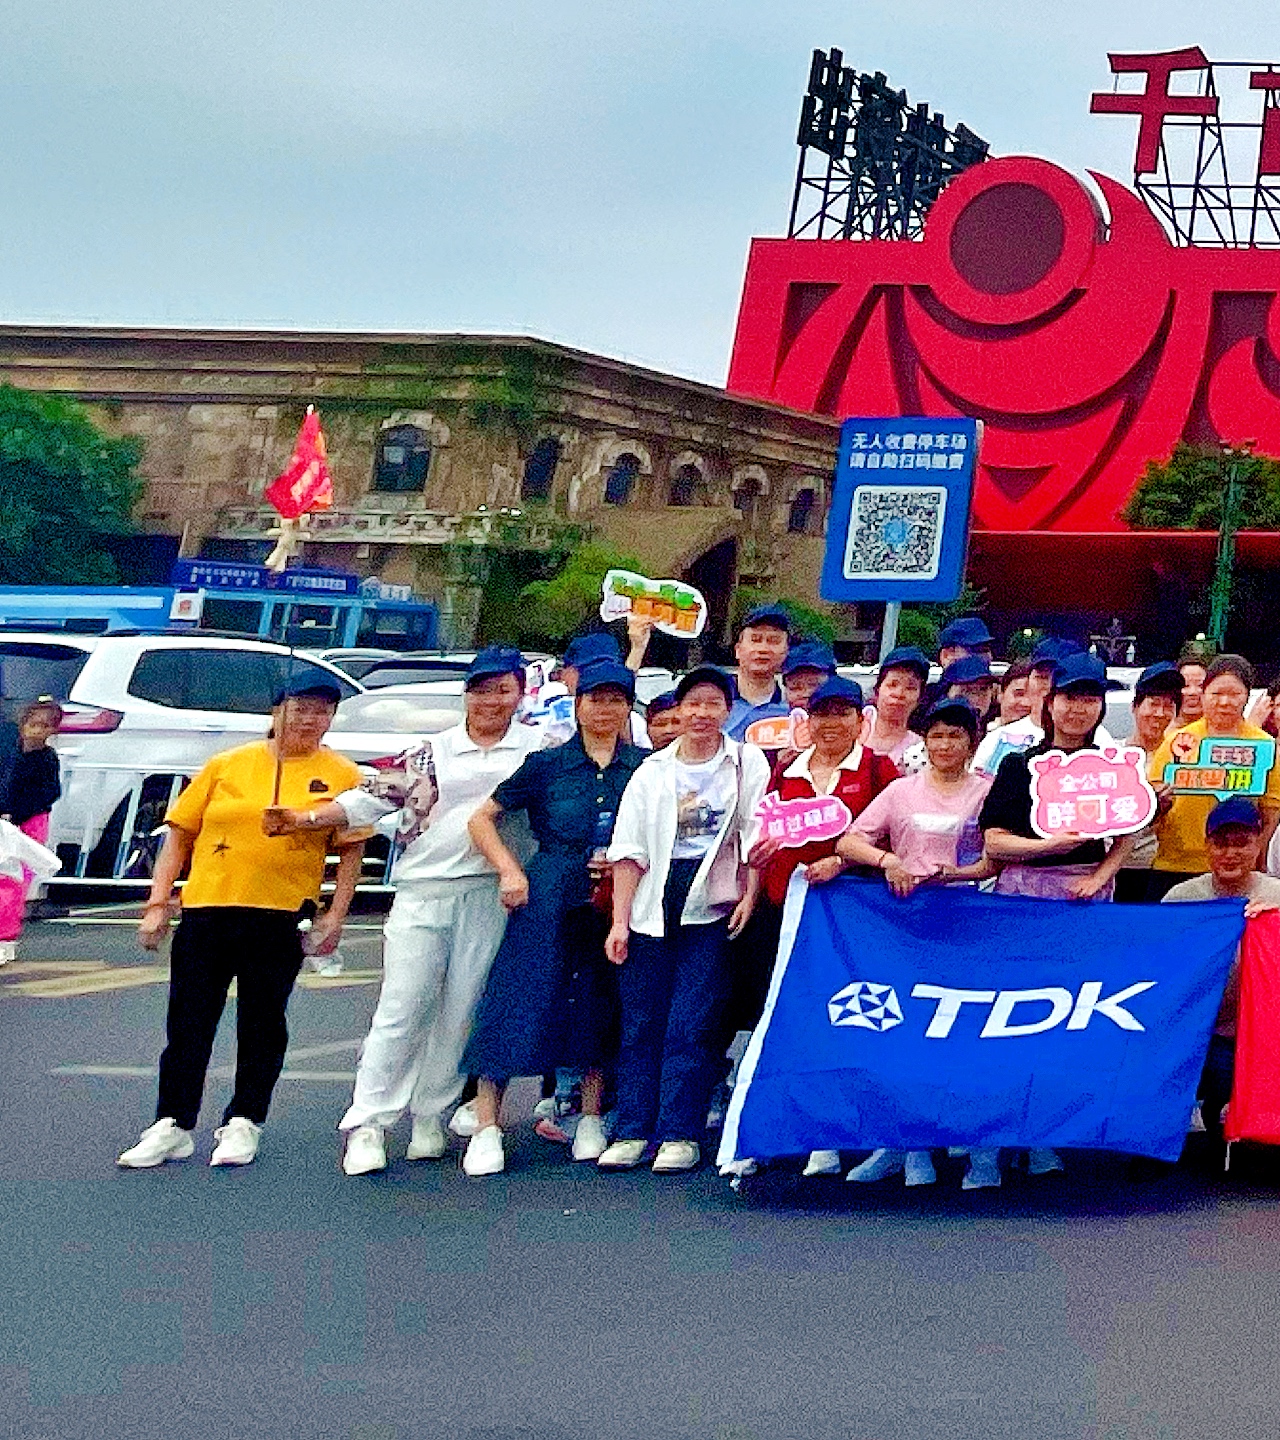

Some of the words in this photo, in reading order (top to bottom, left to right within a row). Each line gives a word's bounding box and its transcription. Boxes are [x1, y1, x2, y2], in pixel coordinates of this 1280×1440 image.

[851, 433, 967, 450] 无人收费停车场
[1057, 771, 1118, 793] 全公司
[1046, 794, 1139, 829] 醉可爱
[910, 980, 1158, 1039] TDK
